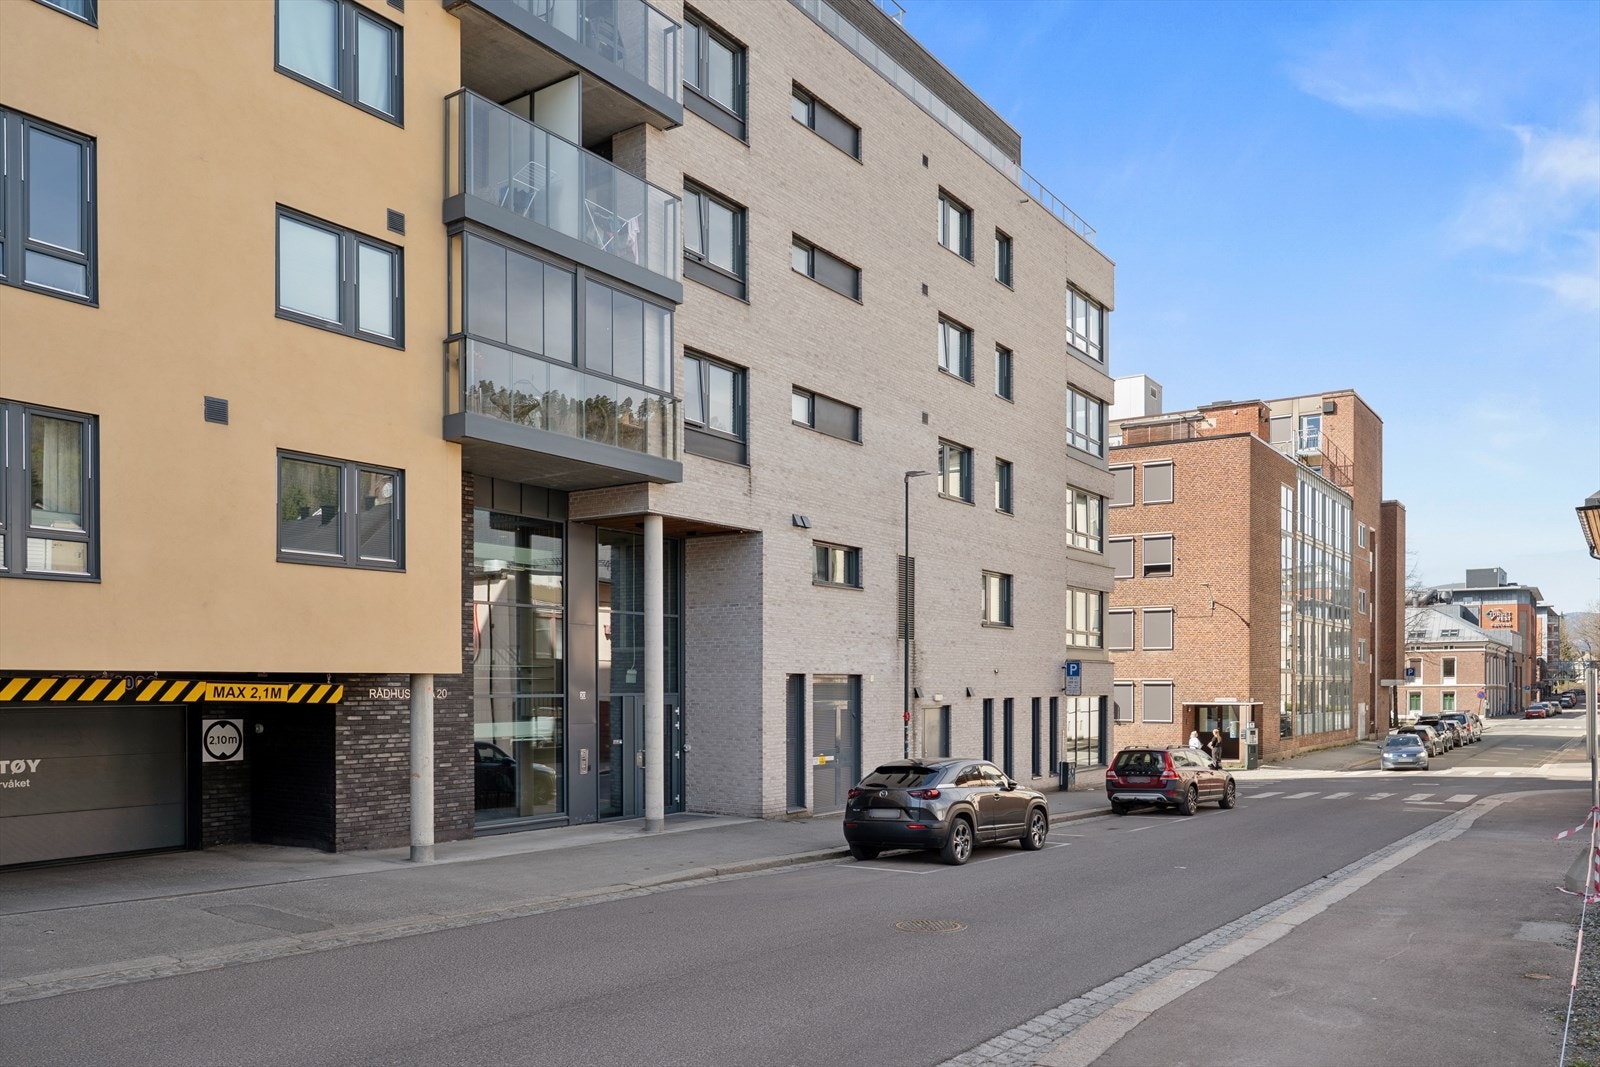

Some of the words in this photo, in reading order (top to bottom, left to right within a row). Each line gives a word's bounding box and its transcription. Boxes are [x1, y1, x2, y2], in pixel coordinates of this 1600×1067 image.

[1070, 664, 1078, 675] P
[213, 686, 246, 698] MAX
[250, 687, 282, 700] 2,1M
[369, 687, 435, 699] RÅDHUS
[437, 688, 448, 699] 20
